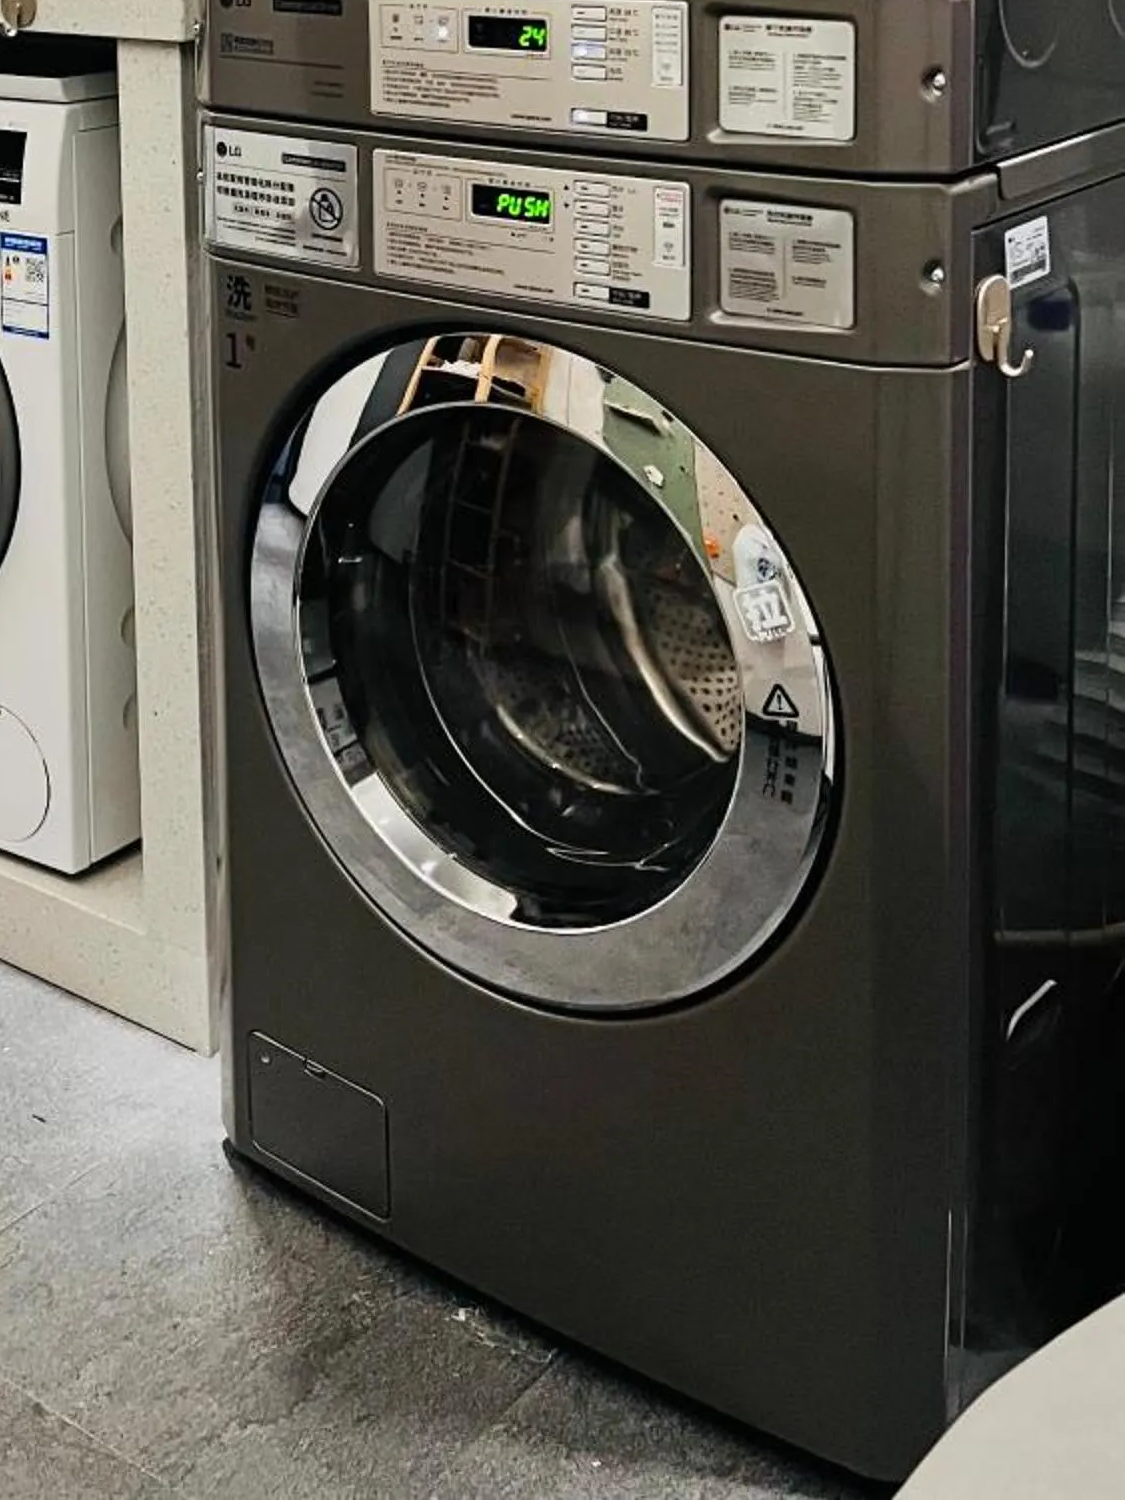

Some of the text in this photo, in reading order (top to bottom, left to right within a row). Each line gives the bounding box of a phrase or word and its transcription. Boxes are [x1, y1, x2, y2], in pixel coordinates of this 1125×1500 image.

[518, 25, 546, 48] 24
[496, 193, 552, 218] PUSH
[225, 275, 253, 312] 洗
[225, 332, 243, 370] 1
